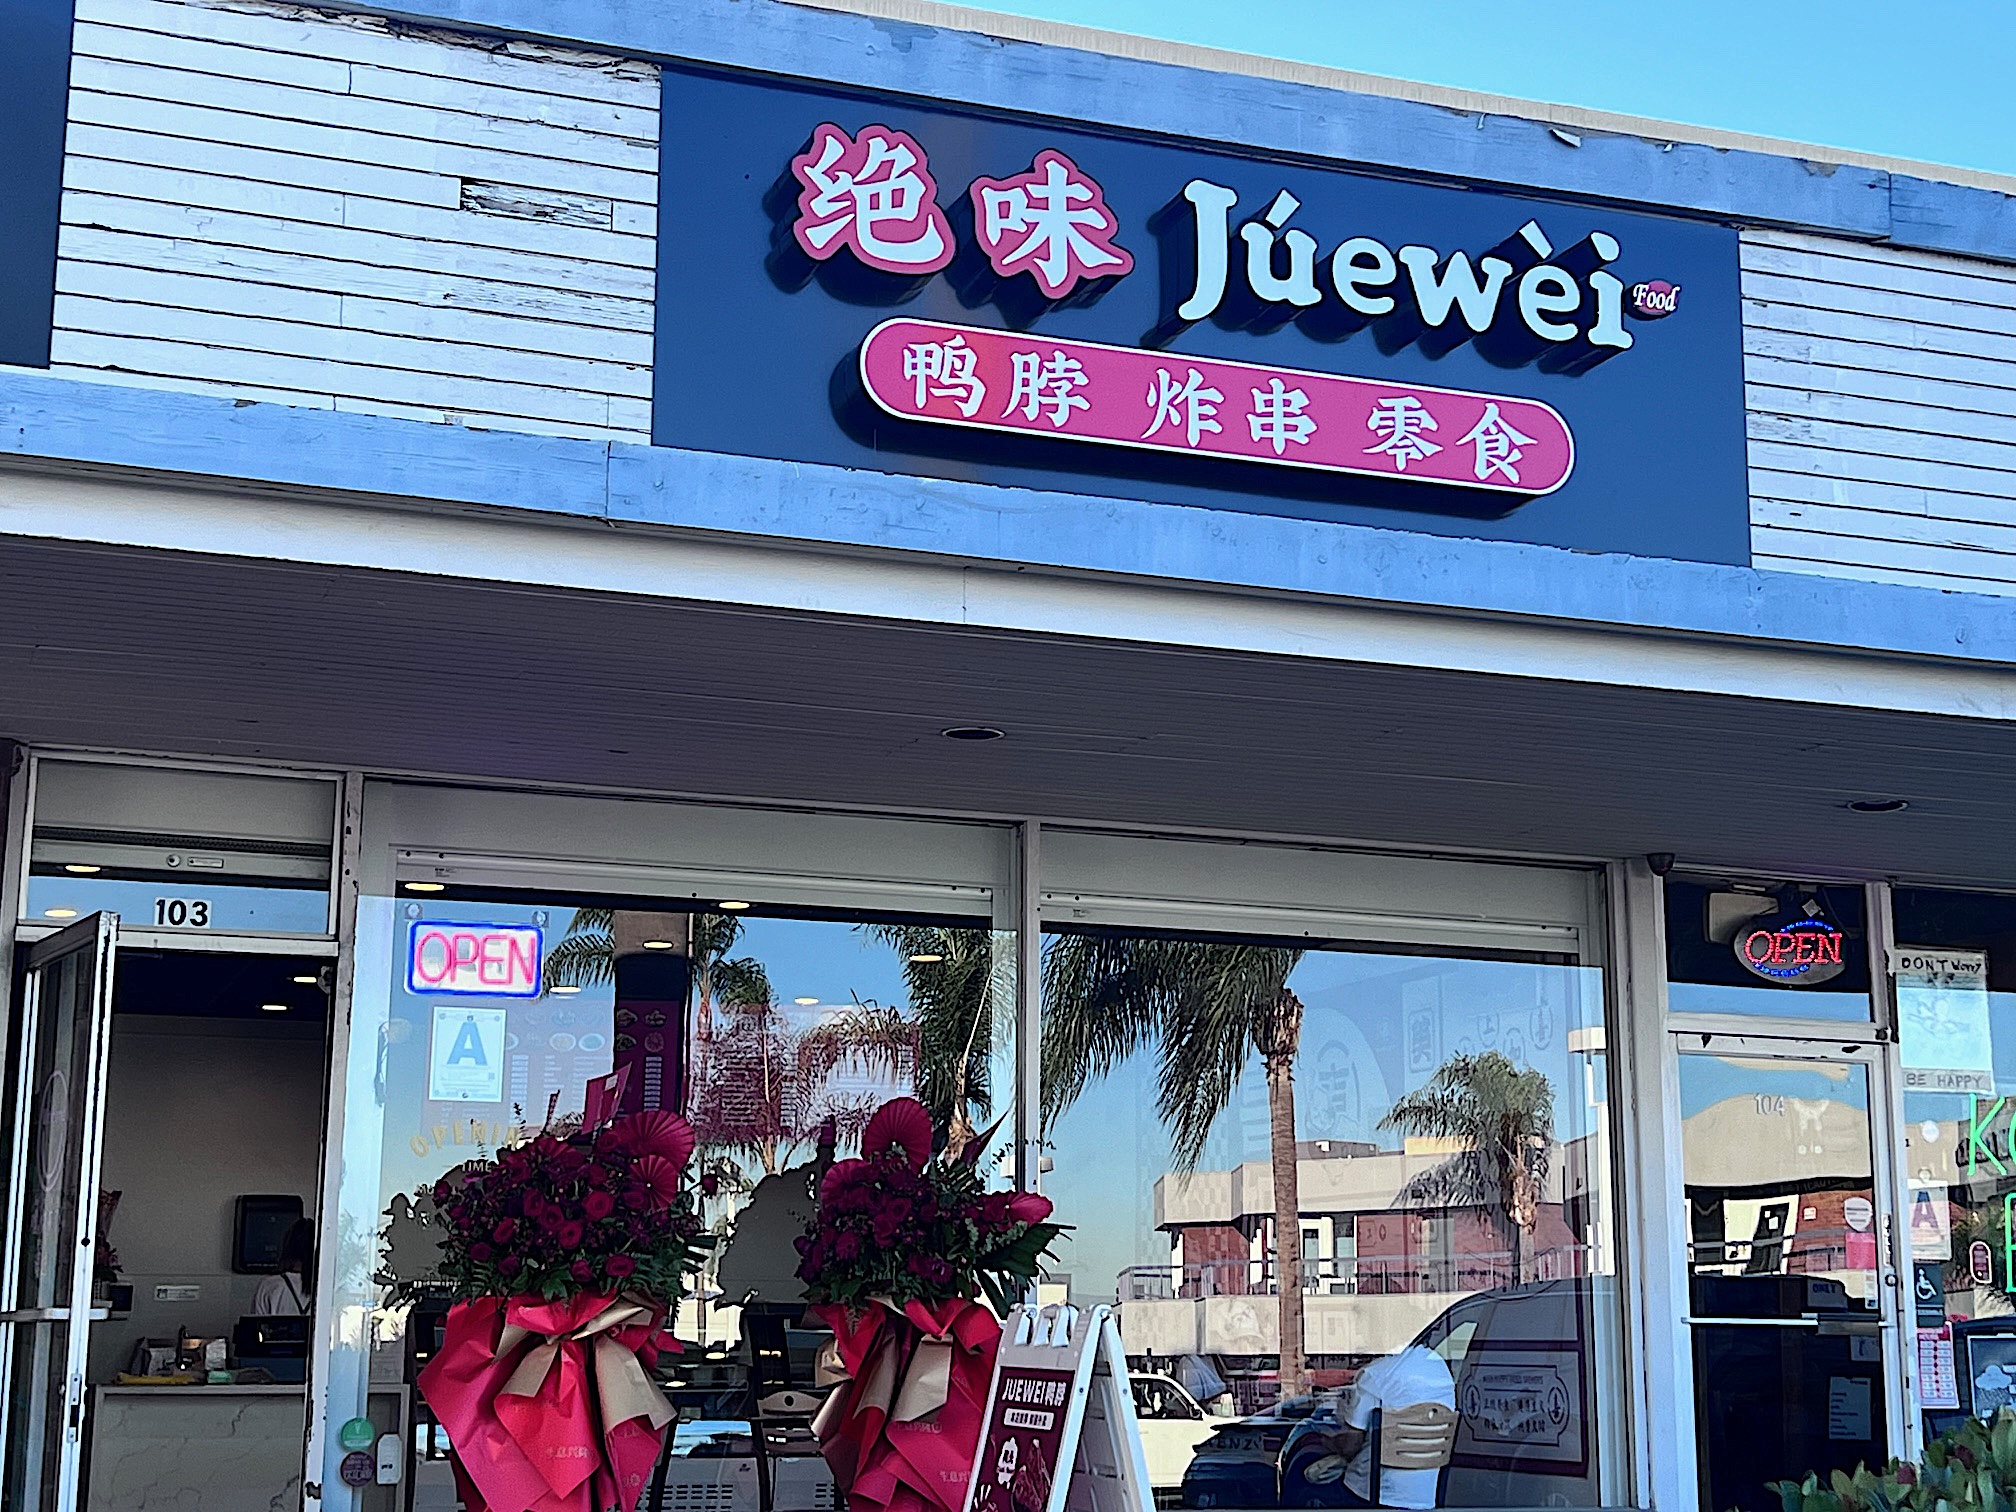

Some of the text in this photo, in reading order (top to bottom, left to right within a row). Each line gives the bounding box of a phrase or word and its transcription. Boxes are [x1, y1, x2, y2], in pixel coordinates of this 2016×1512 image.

[796, 126, 1131, 295] 绝味
[1179, 179, 1681, 349] Júewèi Food
[901, 337, 1538, 484] 鸭脖 炸串 零食
[156, 898, 209, 928] 103
[413, 930, 537, 985] OPEN
[1744, 930, 1843, 965] OPEN
[446, 1021, 489, 1066] A
[1906, 1072, 1984, 1088] BE HAPPY
[1754, 1093, 1786, 1117] 104
[409, 1118, 522, 1158] OPENIN
[462, 1161, 492, 1173] TIME
[1911, 1190, 1939, 1229] A
